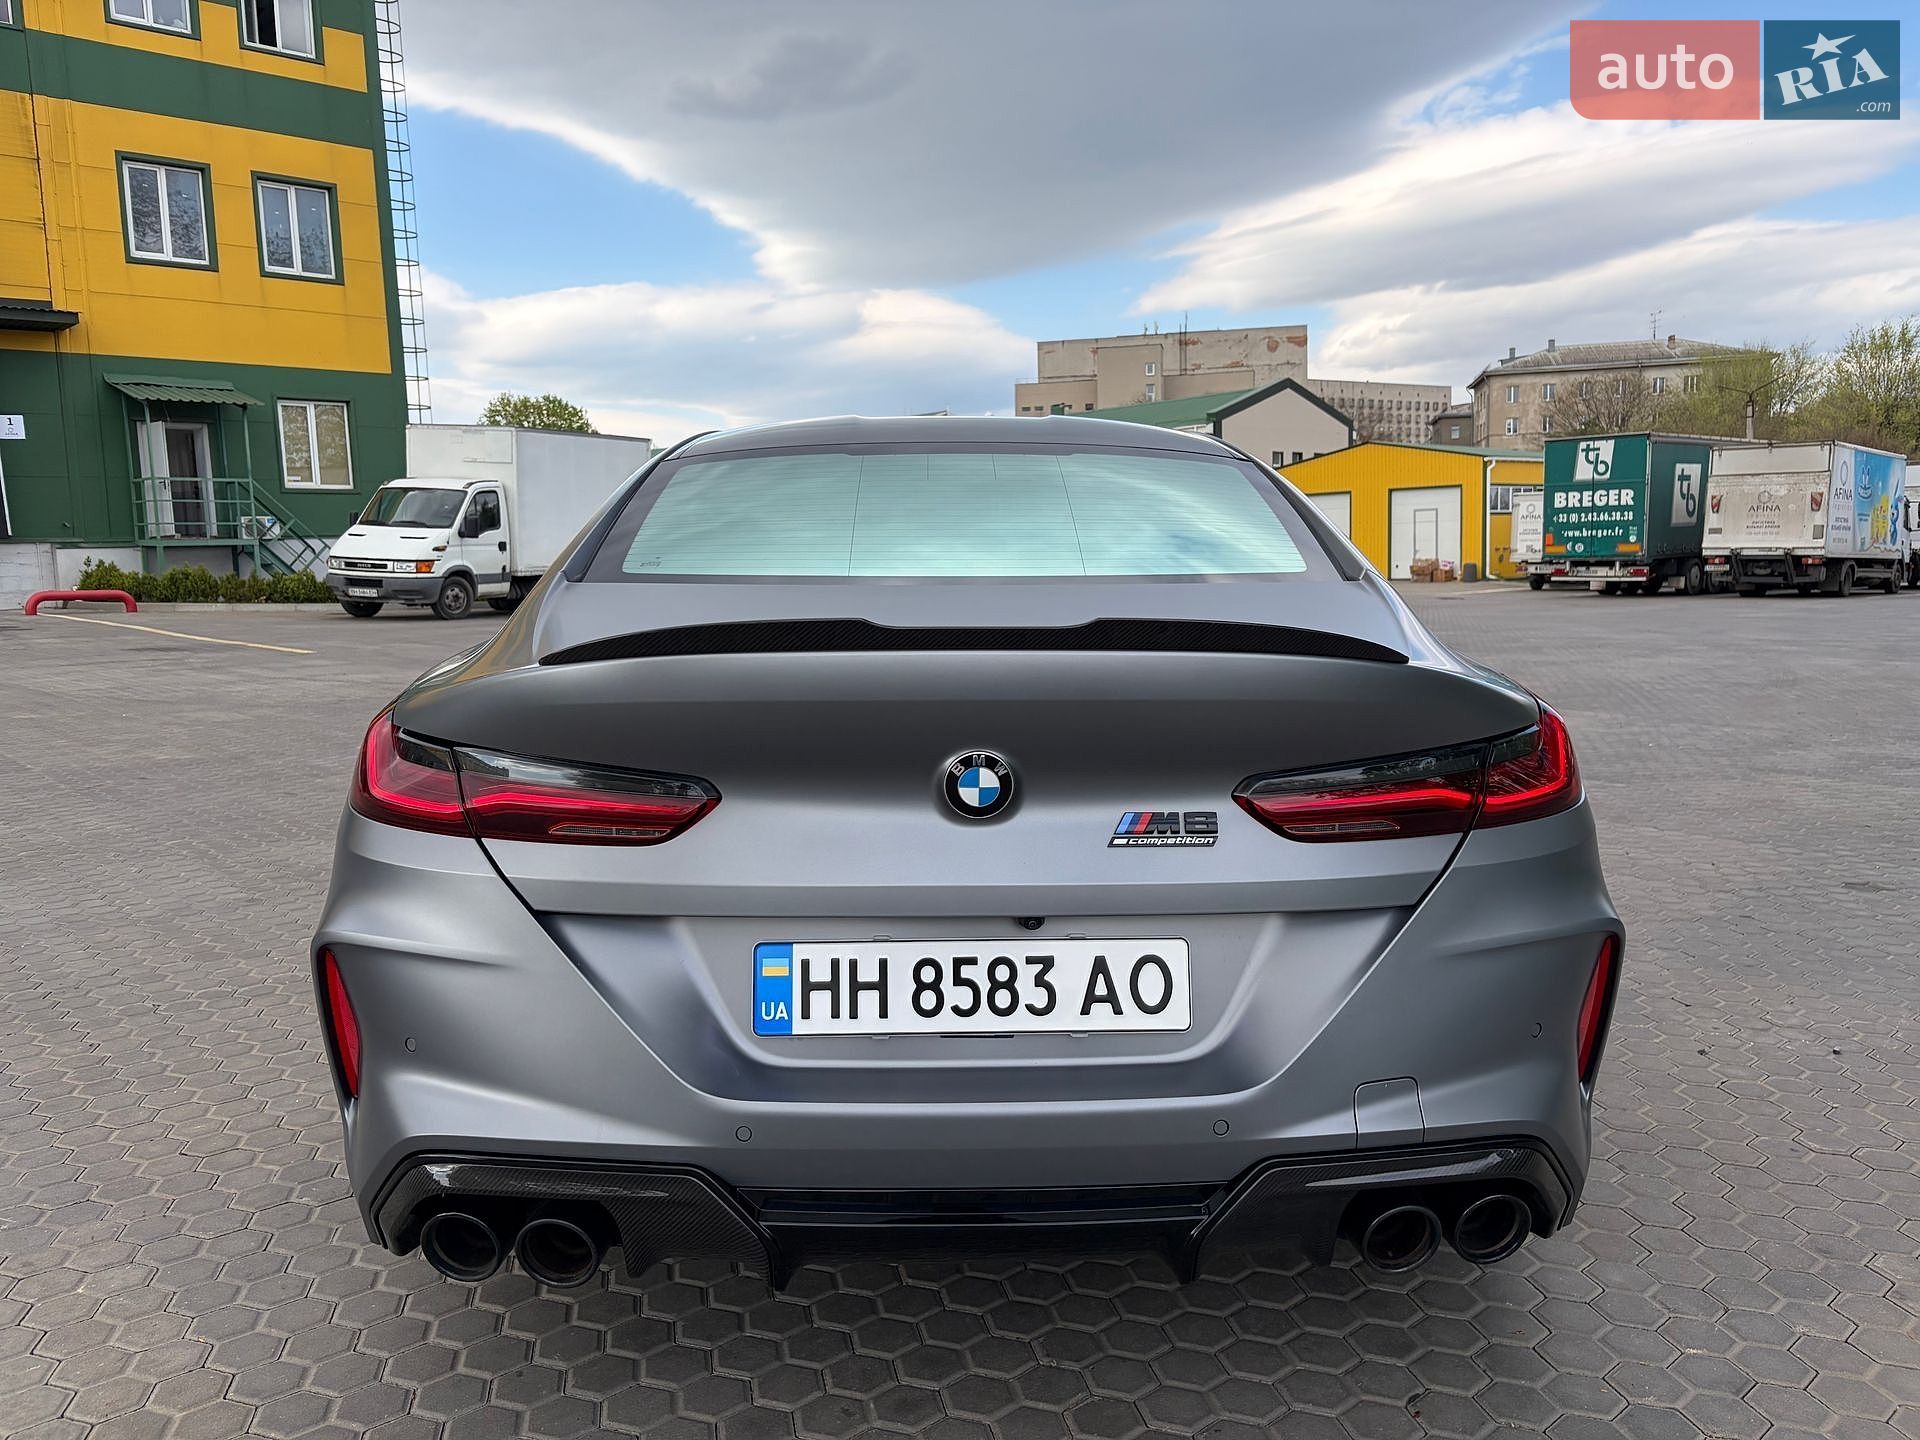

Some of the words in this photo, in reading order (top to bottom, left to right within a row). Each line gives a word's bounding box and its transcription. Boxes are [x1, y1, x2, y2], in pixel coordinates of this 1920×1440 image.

[6, 417, 14, 426] 1
[1554, 488, 1635, 509] BREGER
[1834, 487, 1853, 501] AFINA
[1748, 504, 1781, 512] AFINA
[951, 754, 1007, 778] BMW
[1146, 811, 1219, 835] M8
[1128, 836, 1214, 847] competition
[800, 957, 889, 1020] HH
[911, 954, 1057, 1019] 8583
[1079, 953, 1174, 1016] AO
[761, 1002, 789, 1021] UA
